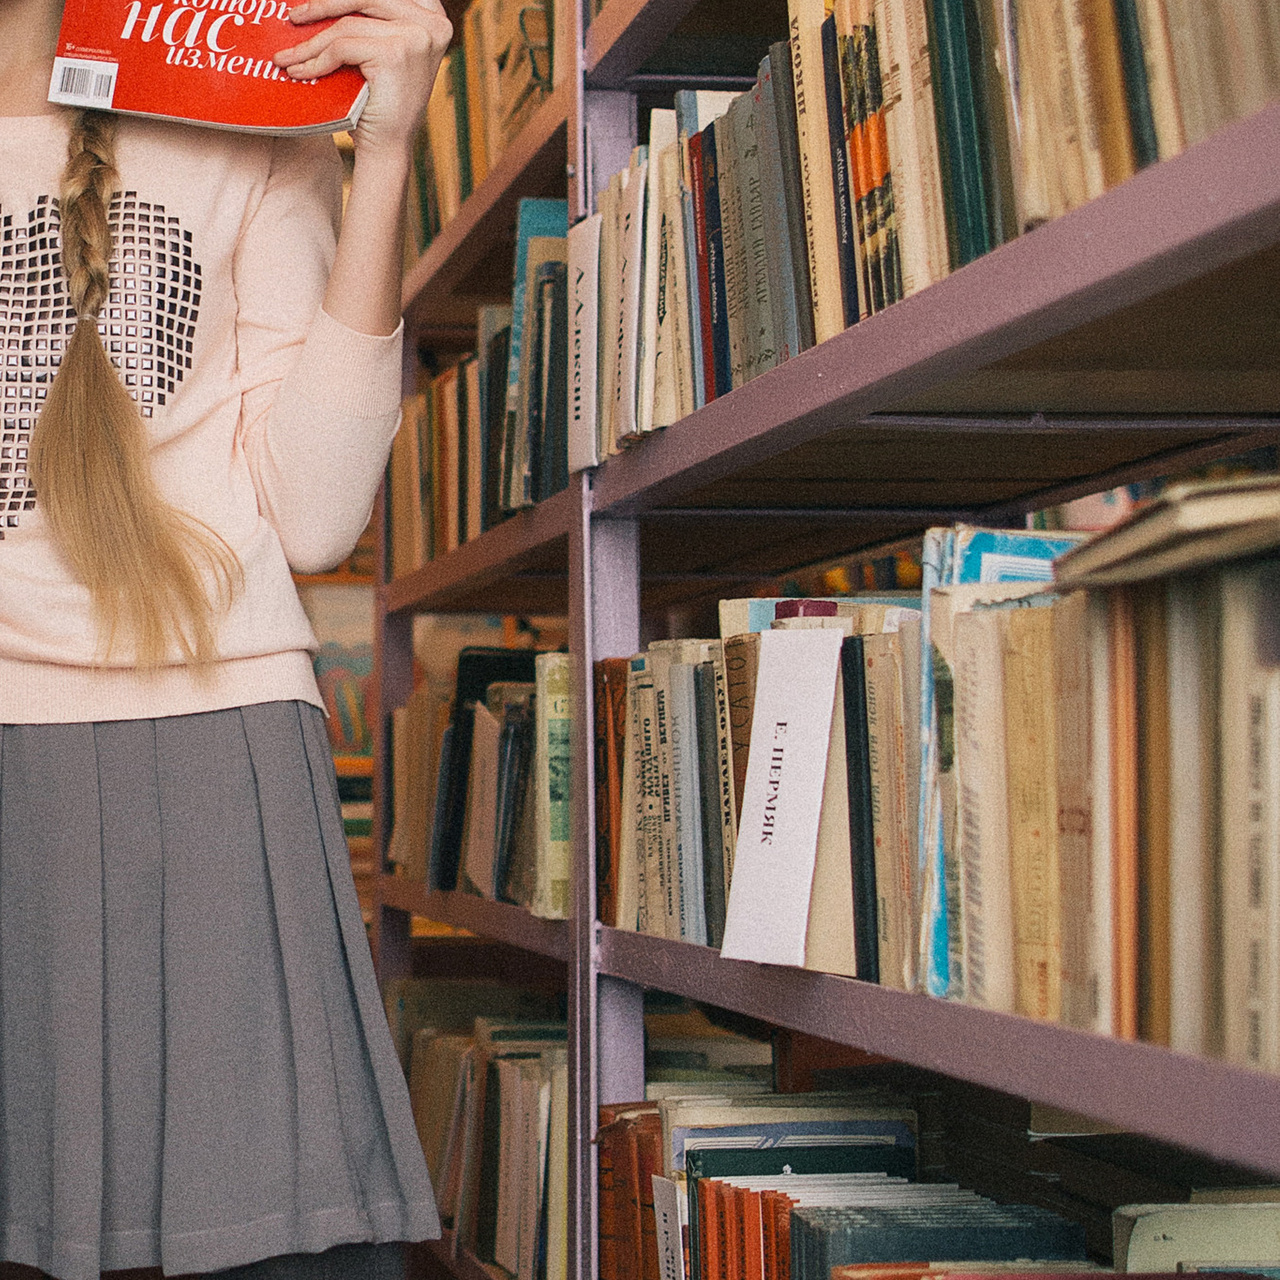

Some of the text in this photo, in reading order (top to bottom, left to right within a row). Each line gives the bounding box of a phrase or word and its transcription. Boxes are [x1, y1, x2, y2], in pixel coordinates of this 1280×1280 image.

[120, 0, 245, 53] нас
[788, 15, 808, 117] ШКОЛА
[720, 198, 739, 320] АРКАДИЙ ГАЙДАР
[748, 176, 768, 305] АРКАДИЙ ГАЙДАР
[656, 689, 667, 745] ВЕРНЕРА
[715, 670, 728, 730] ОМУТ
[644, 717, 655, 799] МЛАДШЕГО
[661, 772, 671, 823] ПРИВЕТ
[718, 735, 732, 827] МАМАЕВ
[760, 721, 788, 846] Е. ПЕРМЯК
